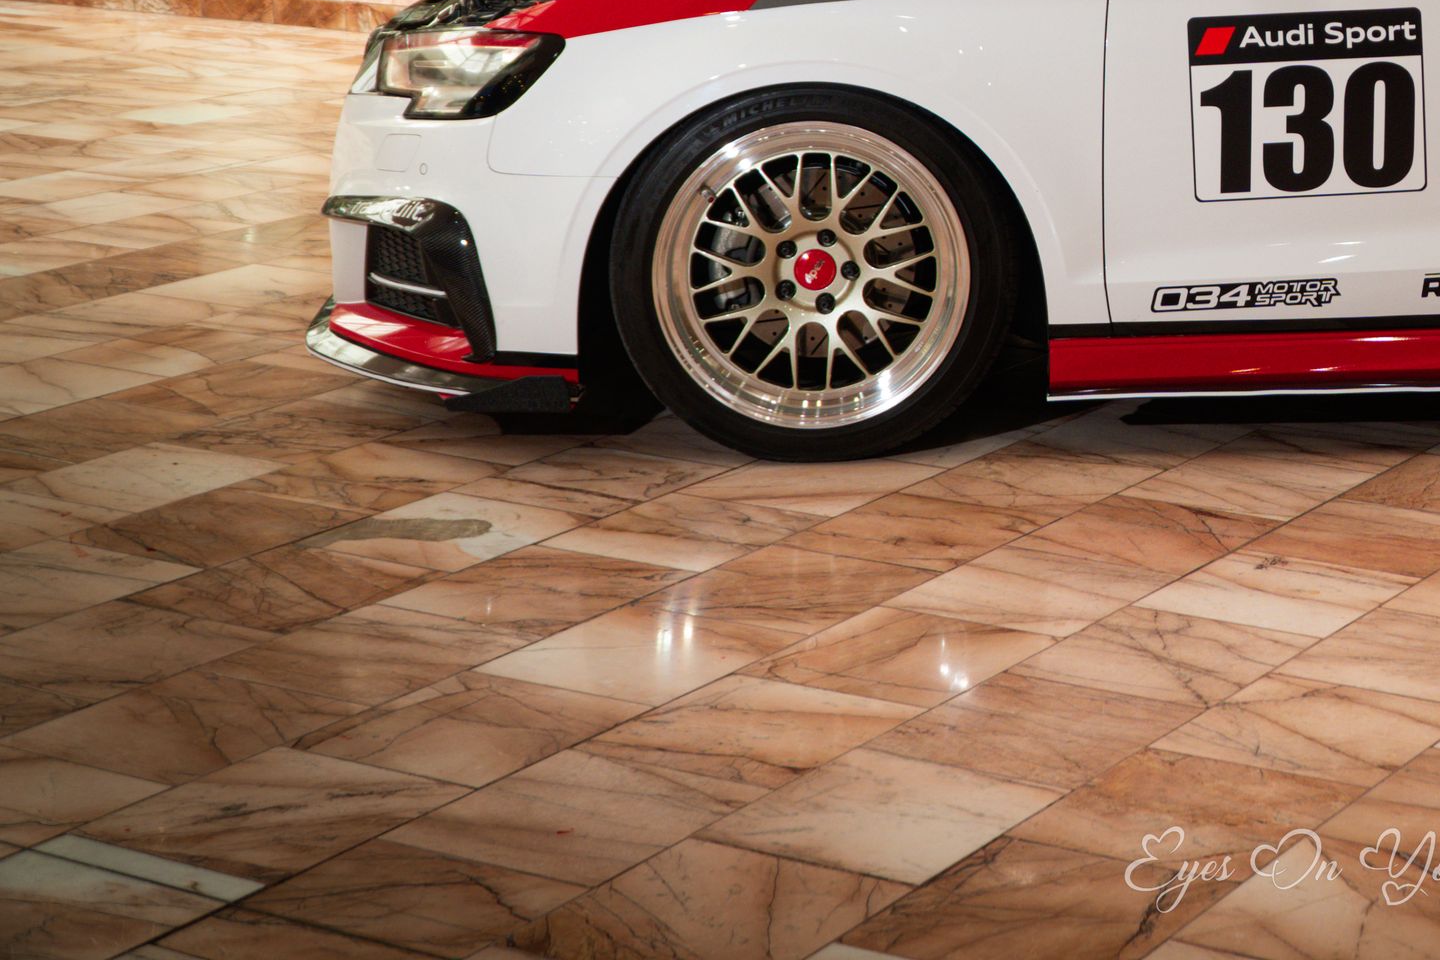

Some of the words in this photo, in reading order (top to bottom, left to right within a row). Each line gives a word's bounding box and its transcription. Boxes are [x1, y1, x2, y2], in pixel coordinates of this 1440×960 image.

[1239, 23, 1314, 48] Audi
[1324, 21, 1417, 49] Sport
[1200, 61, 1415, 194] 130
[1154, 281, 1254, 312] 034
[1254, 278, 1337, 294] MOTOR
[1254, 290, 1337, 307] SPORT
